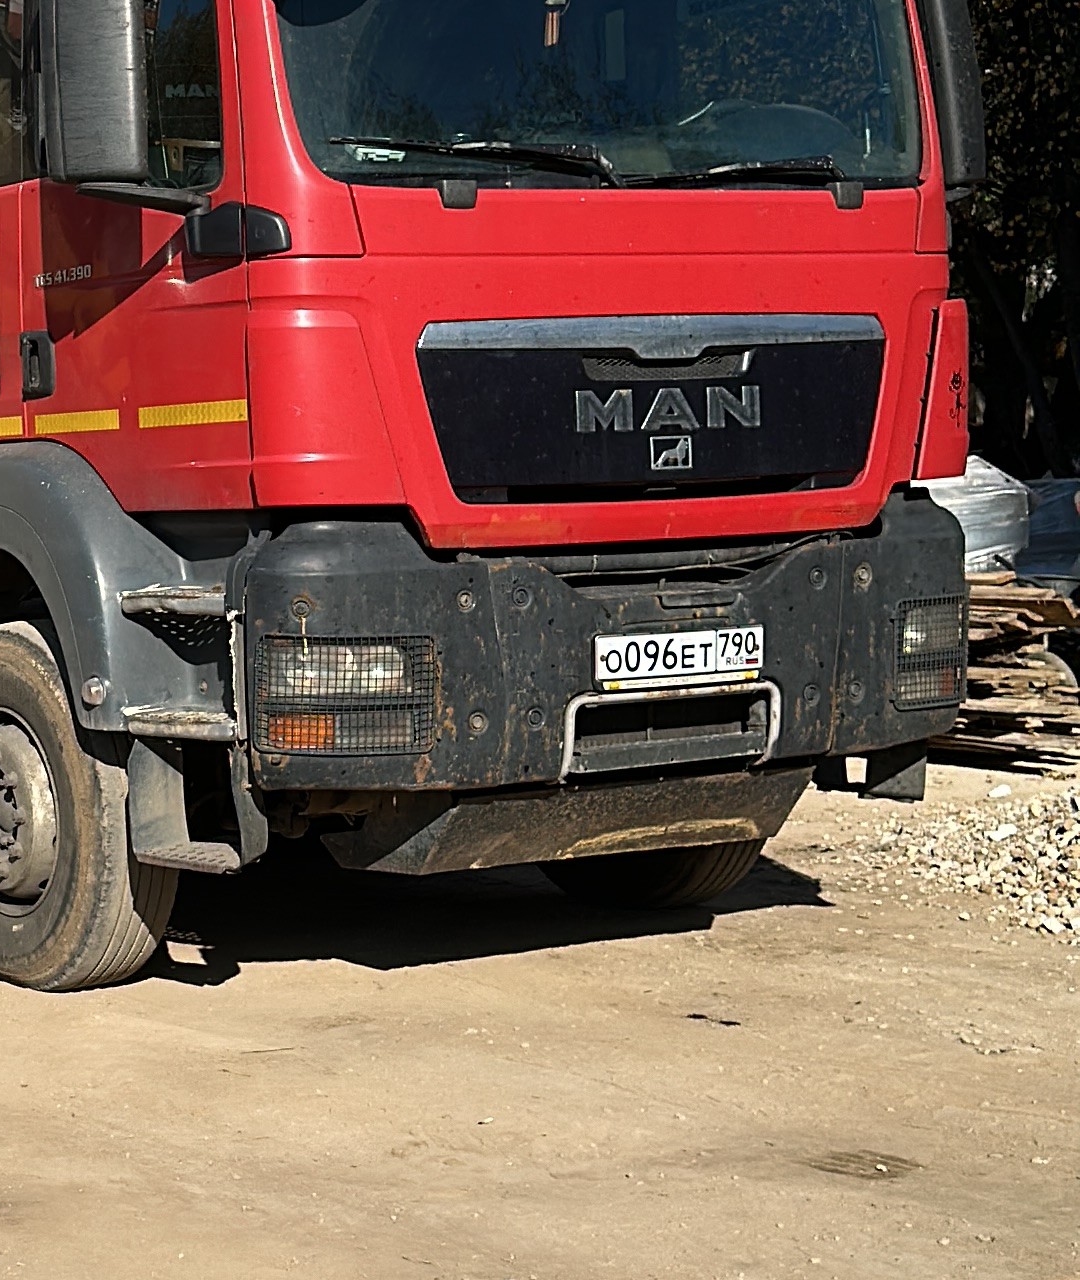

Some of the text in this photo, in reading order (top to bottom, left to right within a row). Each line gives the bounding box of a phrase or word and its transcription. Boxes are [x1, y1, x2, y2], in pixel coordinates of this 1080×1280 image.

[575, 385, 761, 432] MAN
[718, 631, 756, 657] 790
[725, 656, 744, 666] RUS
